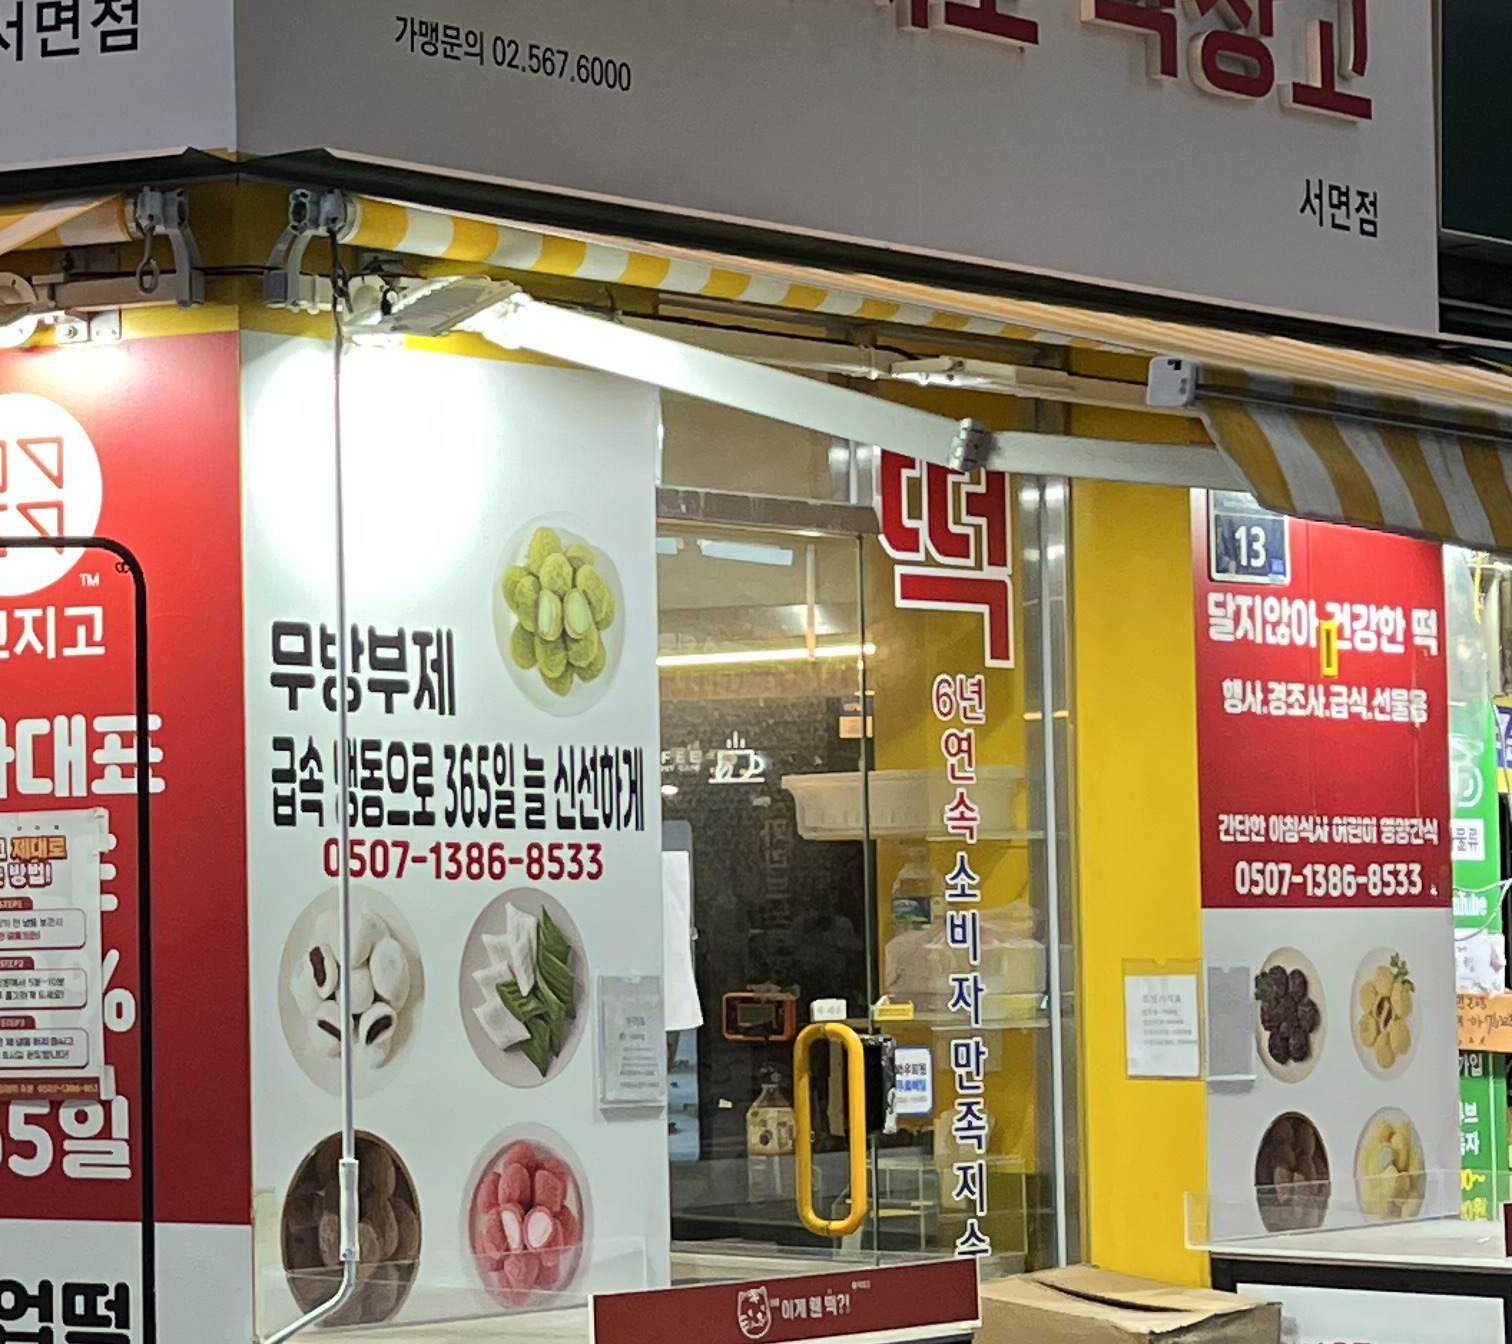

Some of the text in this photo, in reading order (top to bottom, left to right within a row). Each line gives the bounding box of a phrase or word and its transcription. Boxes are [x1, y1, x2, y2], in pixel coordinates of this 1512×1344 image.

[395, 16, 632, 92] 가맹문의 02.567.6000
[1299, 179, 1379, 238] 서면점
[1235, 526, 1266, 567] 13
[79, 573, 100, 587] TM
[1207, 592, 1439, 656] 달지않아 건강한 떡
[270, 621, 456, 716] 무방부제
[272, 735, 324, 828] 급속
[444, 743, 517, 830] 365일
[524, 744, 547, 831] 늘
[554, 745, 645, 831] 신선하게
[10, 835, 68, 860] 제대로
[1218, 813, 1266, 842] 간단한
[1268, 814, 1329, 844] 아침식사
[1332, 816, 1377, 844] 어린이
[1380, 817, 1439, 845] 영양간식
[323, 837, 604, 881] 0507-1386-8533
[1235, 860, 1422, 897] 0507-1386-8533
